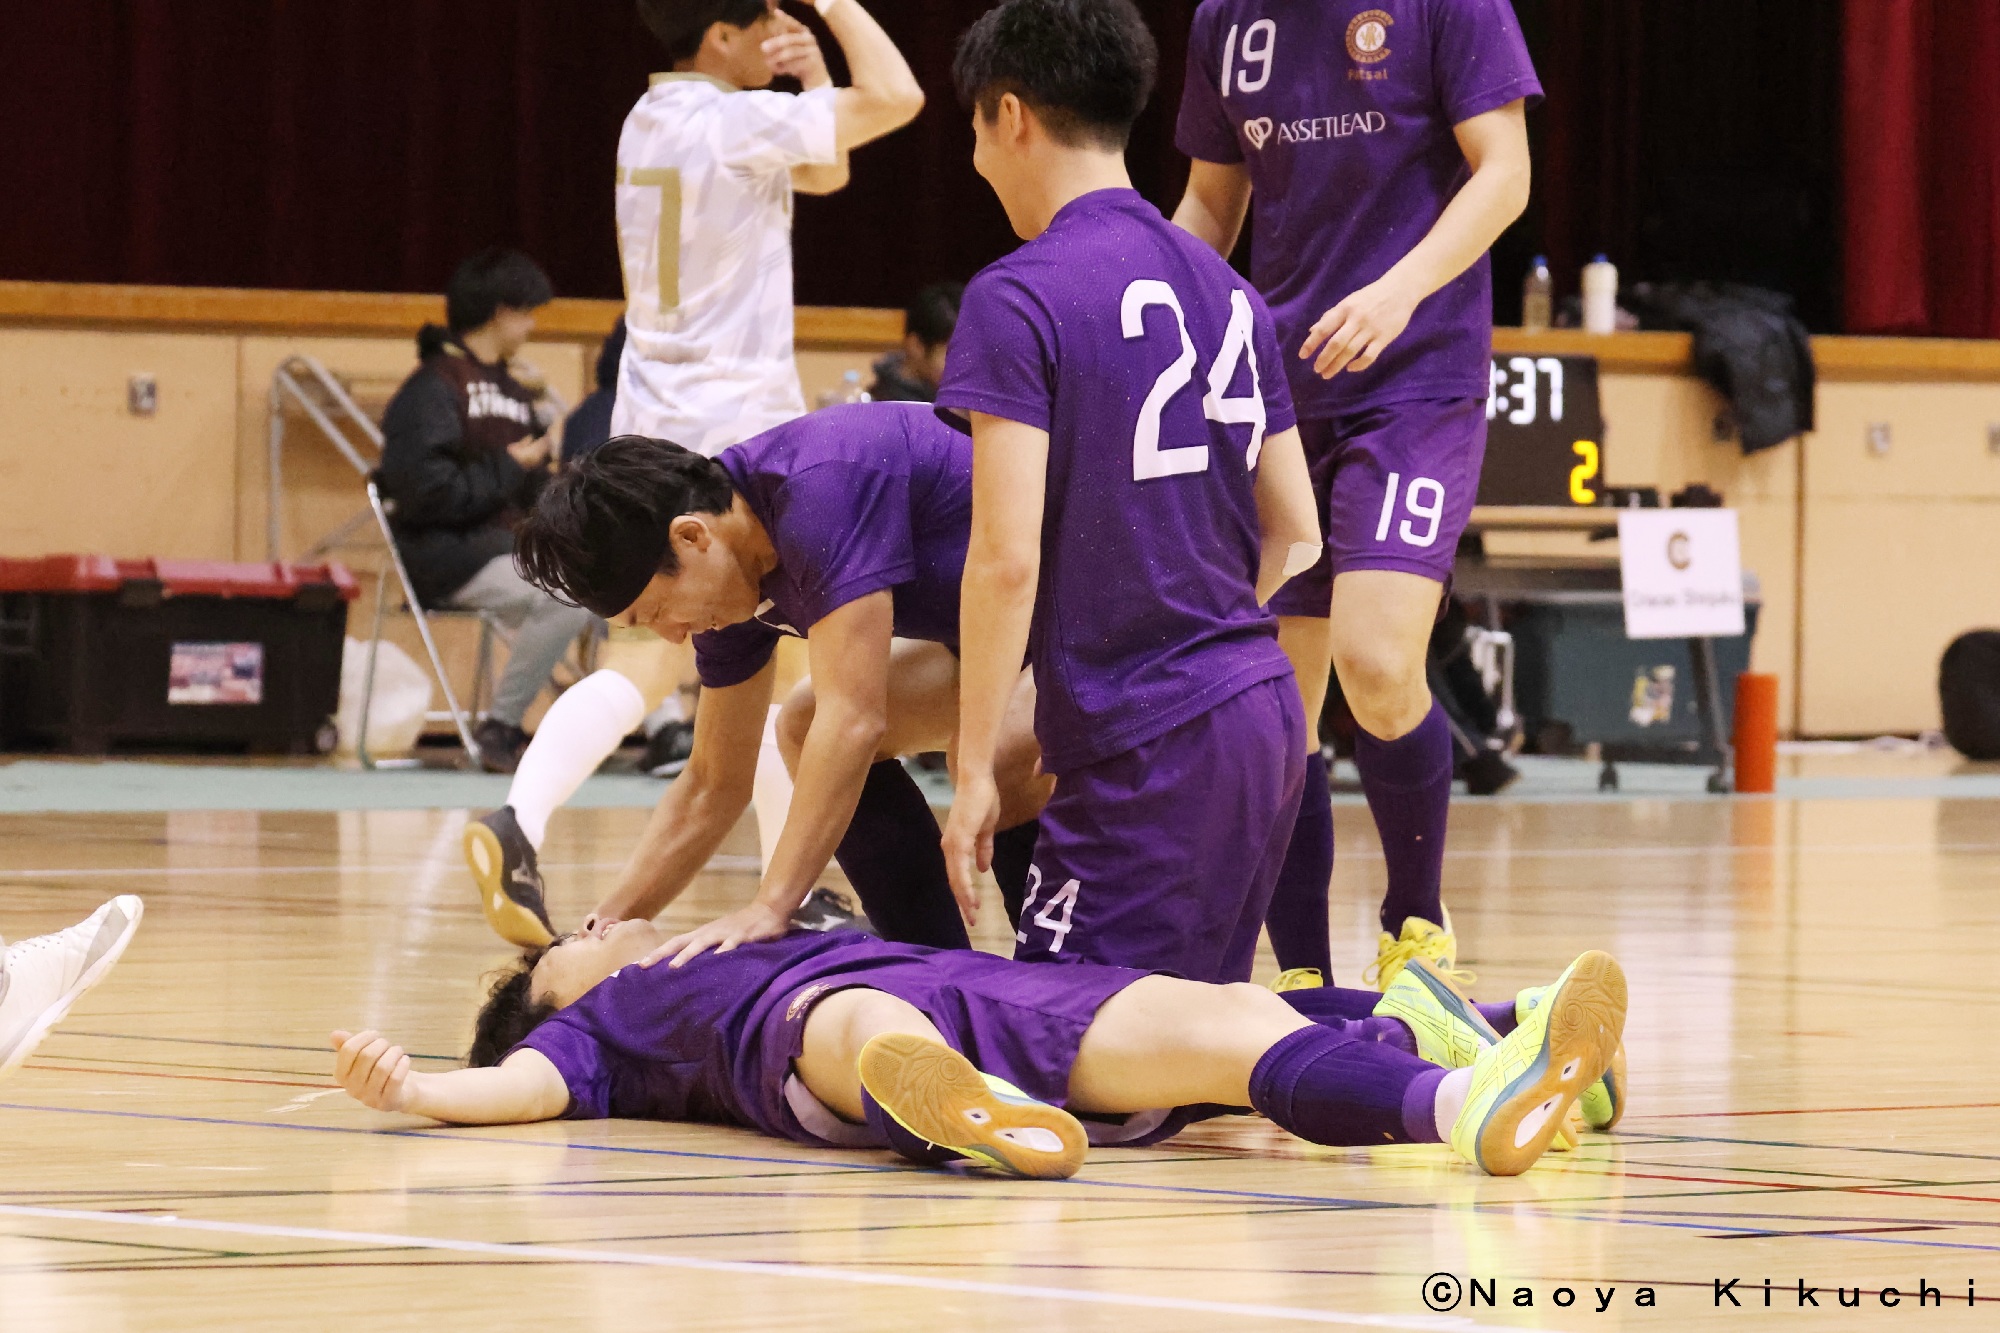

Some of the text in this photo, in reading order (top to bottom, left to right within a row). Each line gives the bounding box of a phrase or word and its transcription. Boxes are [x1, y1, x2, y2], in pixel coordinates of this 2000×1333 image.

[1221, 18, 1276, 97] 19
[1277, 111, 1386, 145] ASSETLEAD
[615, 166, 682, 314] 7
[1120, 279, 1267, 482] 24
[1375, 472, 1445, 547] 19
[1569, 440, 1599, 504] 2
[1016, 863, 1081, 953] 24
